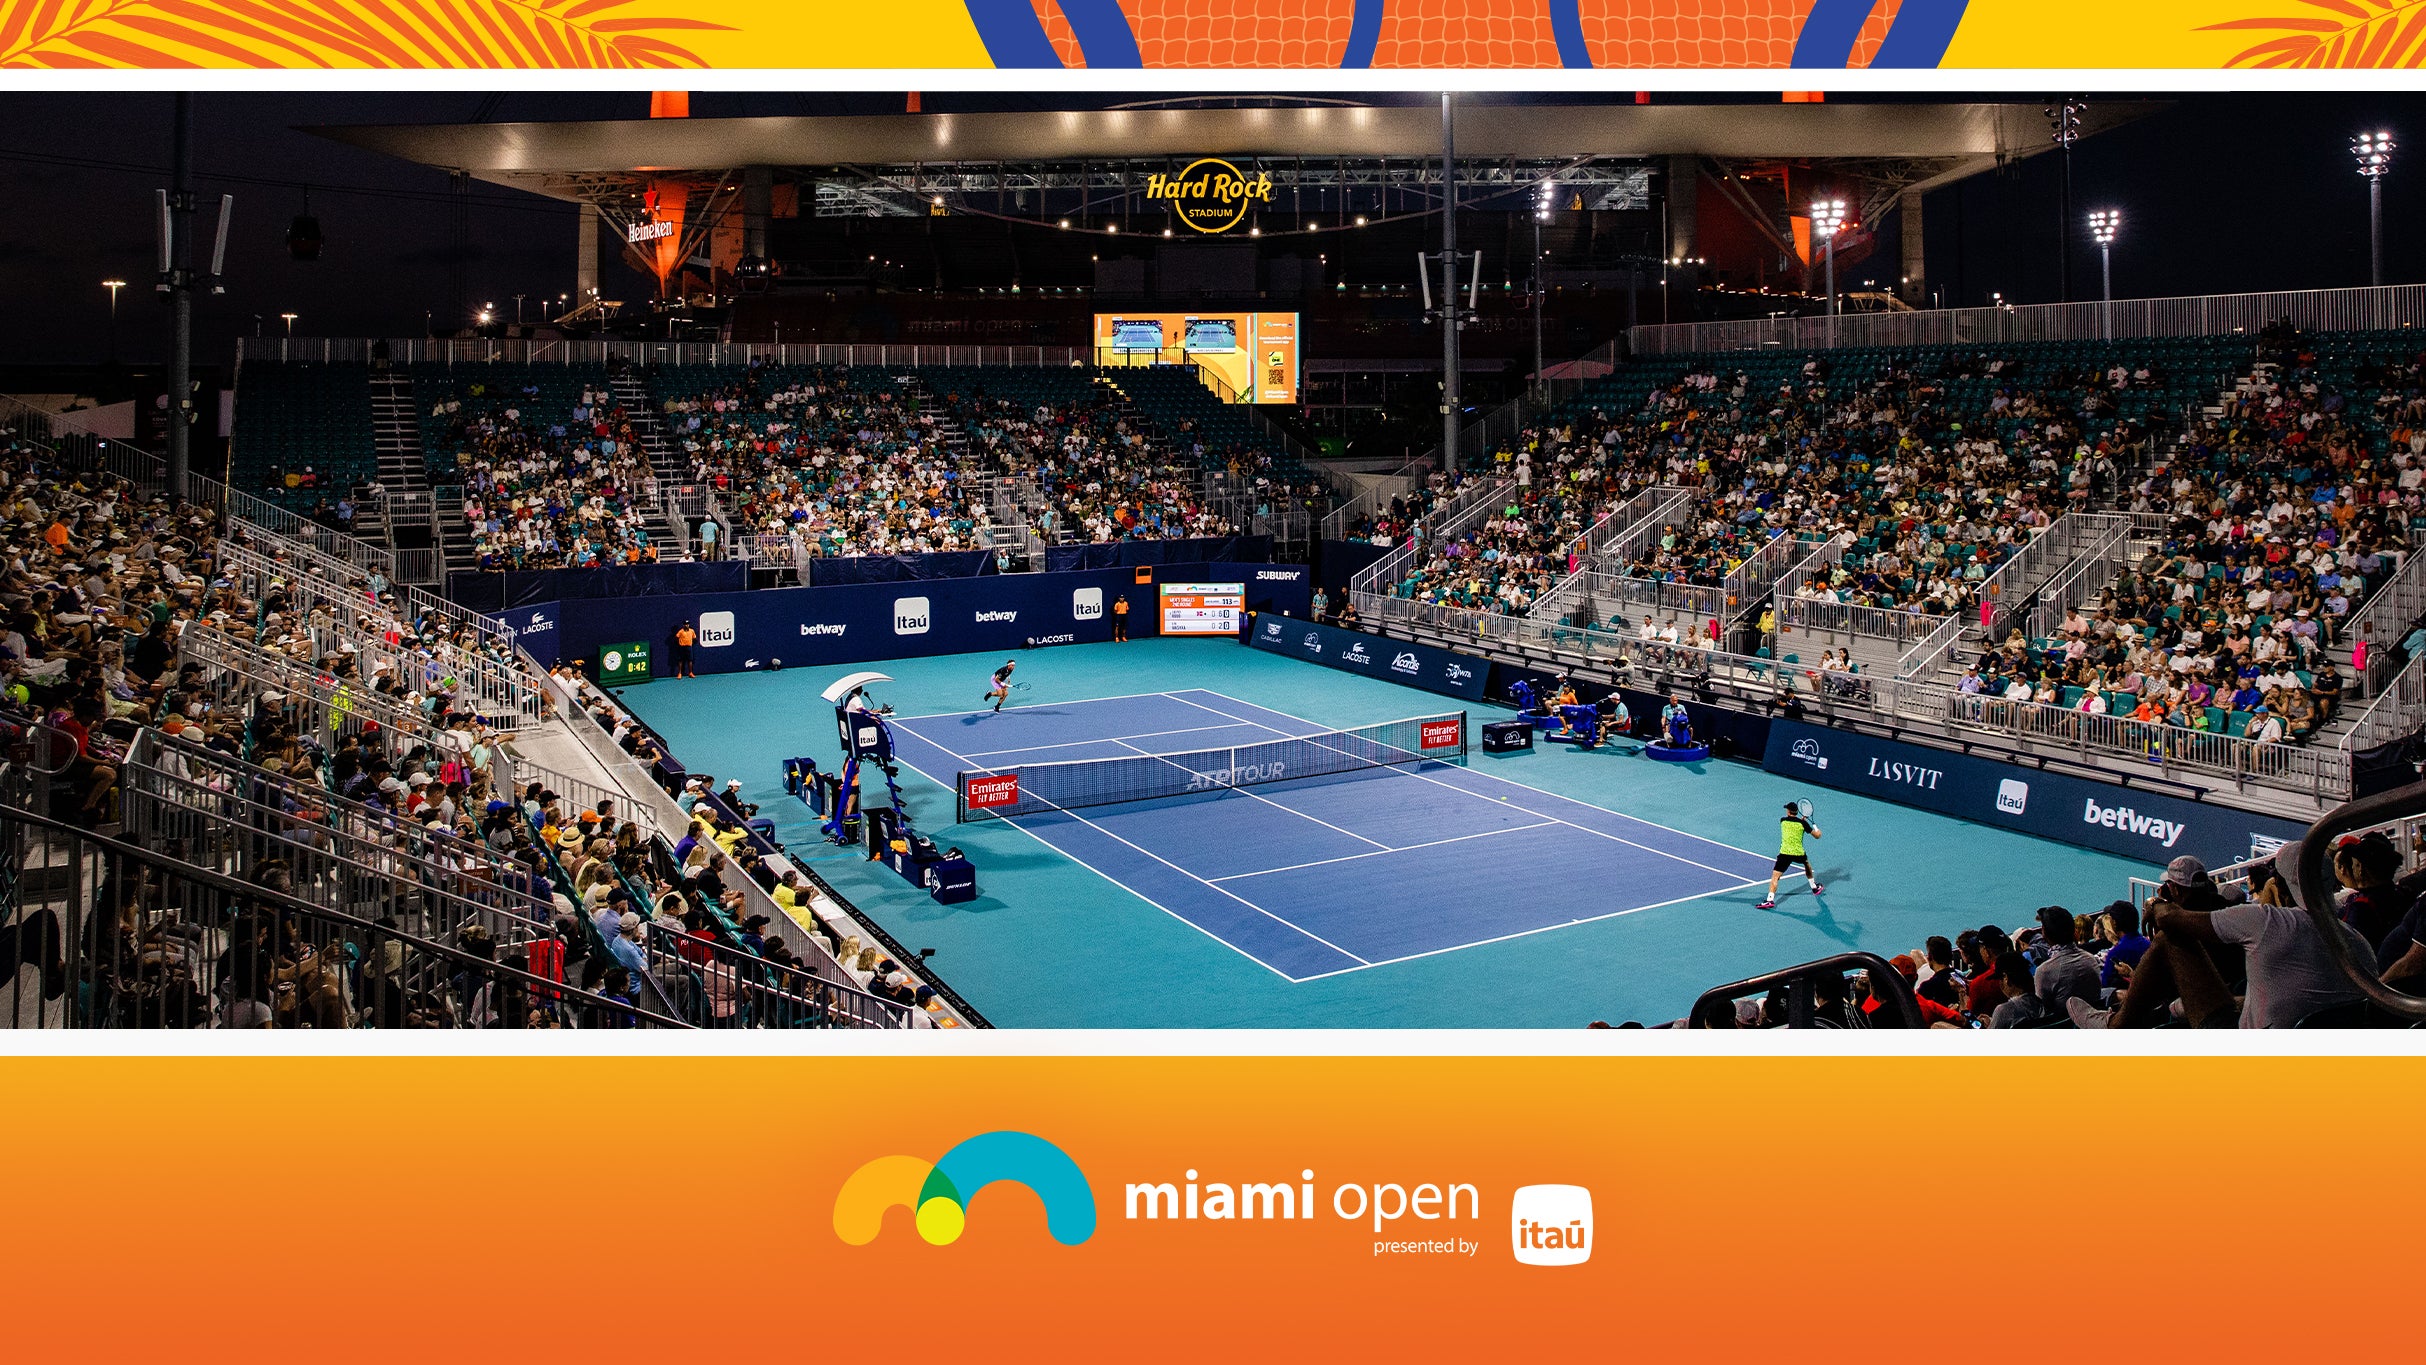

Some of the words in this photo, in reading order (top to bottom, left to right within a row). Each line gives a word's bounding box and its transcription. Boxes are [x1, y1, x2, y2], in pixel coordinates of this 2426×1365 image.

[1146, 173, 1210, 199] Hard
[1212, 173, 1273, 204] Rock
[1188, 208, 1233, 218] STADIUM
[628, 219, 673, 243] Heineken
[1256, 570, 1300, 581] SUBWAY
[1076, 602, 1101, 615] Itaú
[897, 614, 927, 629] Itaú
[975, 610, 1017, 622] betway
[522, 620, 554, 635] LACOSTE
[702, 627, 732, 642] Itaú
[800, 623, 847, 636] betway
[1036, 633, 1074, 645] LACOSTE
[1260, 634, 1283, 643] CADILLAC
[1342, 650, 1371, 665] LACOSTE
[1391, 651, 1420, 671] Acordis
[627, 661, 646, 672] 0:42
[1423, 724, 1458, 737] Emirates
[860, 735, 876, 744] Itaú
[1186, 768, 1232, 790] ATP
[1234, 761, 1285, 784] TOUR
[1868, 757, 1943, 790] LASVIT
[971, 780, 1017, 795] Emirates
[978, 793, 988, 803] FLY
[988, 791, 1009, 802] BETTER
[1999, 793, 2023, 810] Itaú
[2083, 797, 2185, 848] betway
[945, 881, 972, 890] DUNLOP
